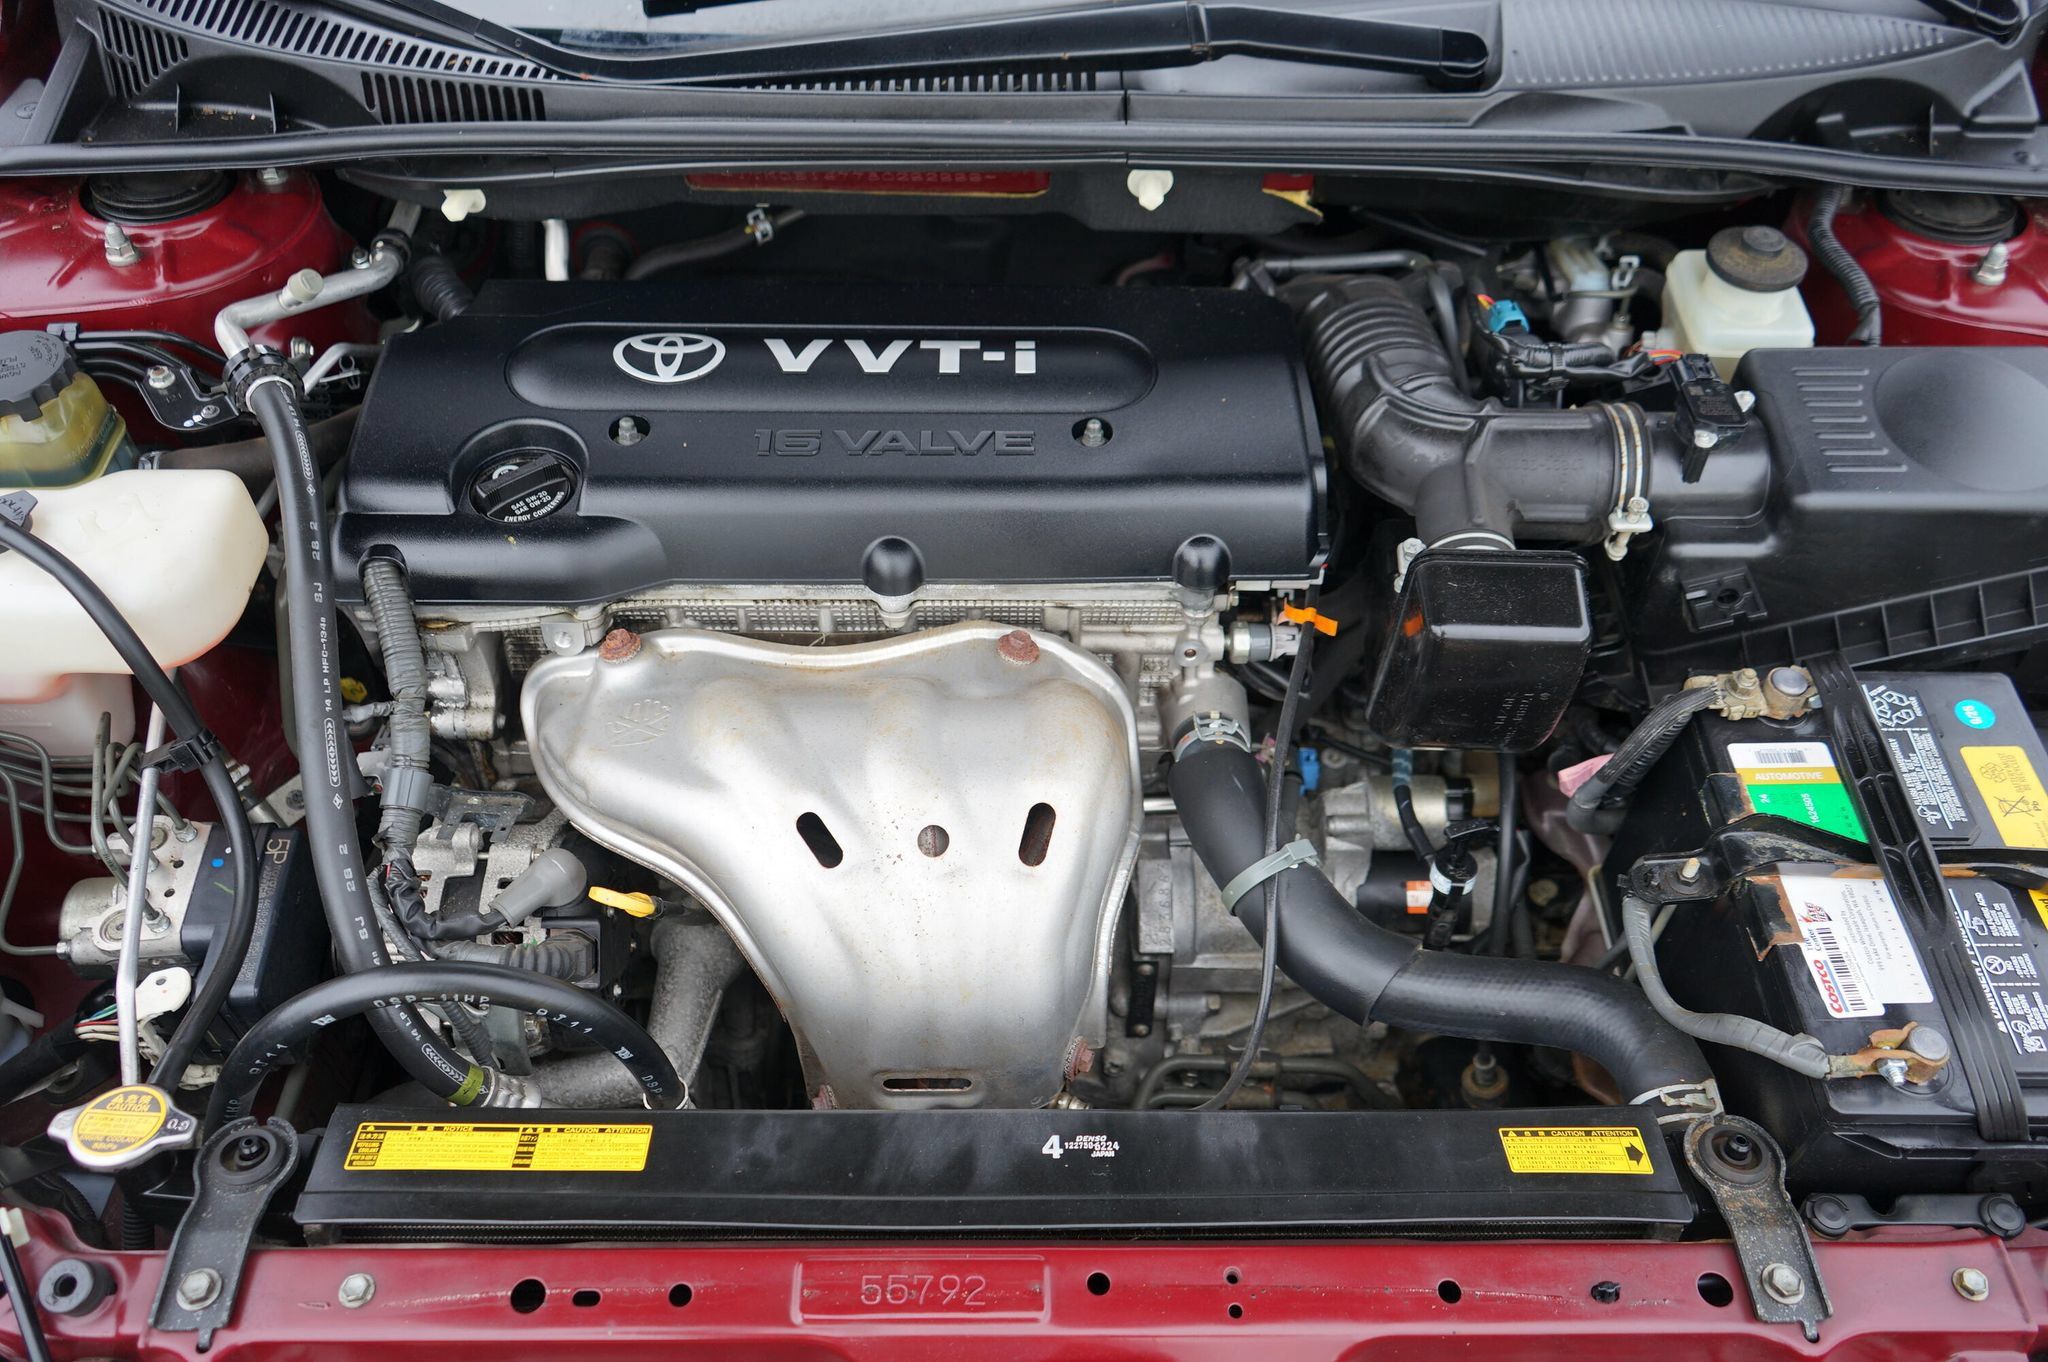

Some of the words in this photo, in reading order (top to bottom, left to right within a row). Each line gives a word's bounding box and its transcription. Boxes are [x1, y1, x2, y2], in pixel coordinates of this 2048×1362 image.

[764, 338, 1036, 374] VVT-i
[754, 429, 822, 457] 16
[833, 430, 1036, 457] VALVE
[504, 514, 531, 522] ENERGY
[1755, 771, 1824, 780] AUTOMOTIVE
[1808, 928, 1822, 952] Center
[1813, 959, 1843, 1014] COSTCO
[1999, 991, 2017, 1014] SHIELD
[2015, 994, 2040, 1029] EXPLOSIVE
[399, 1011, 412, 1027] LP
[106, 1103, 150, 1112] CAUTION
[1042, 1134, 1064, 1159] 4
[1091, 1150, 1115, 1158] JAPAN
